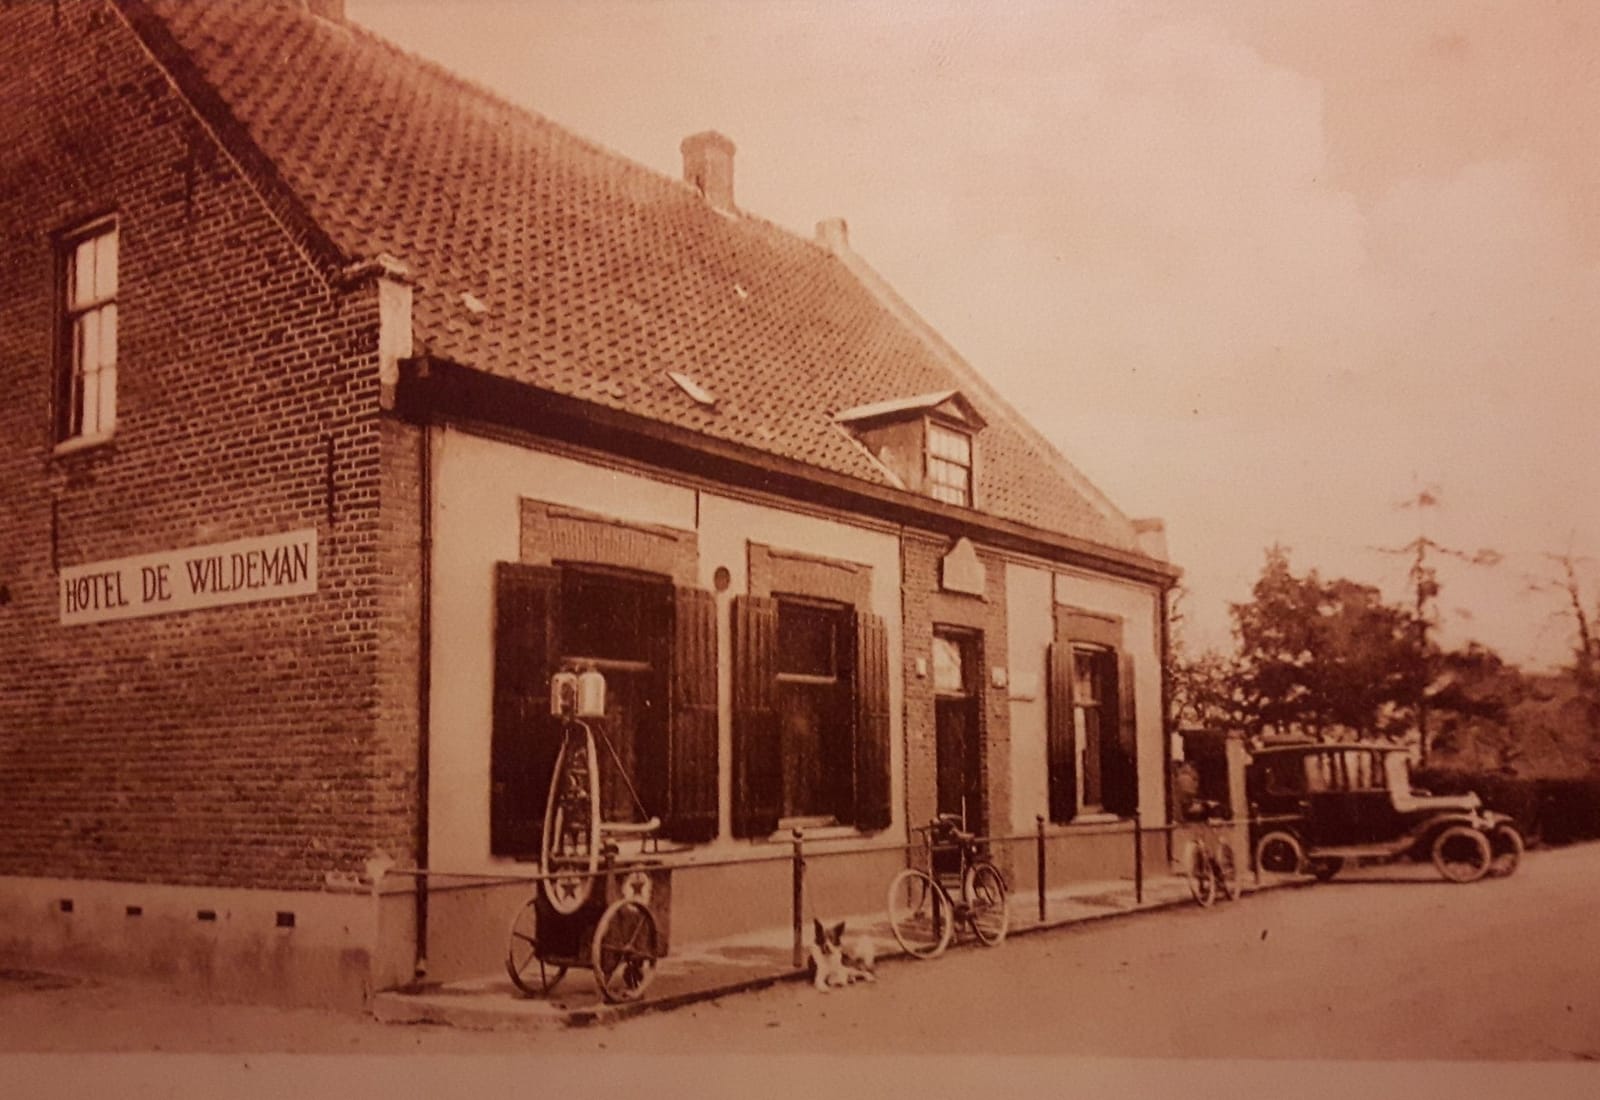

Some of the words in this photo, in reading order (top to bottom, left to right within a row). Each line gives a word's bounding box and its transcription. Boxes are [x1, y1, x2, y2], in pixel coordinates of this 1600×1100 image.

[64, 571, 129, 613] HOTEL
[142, 564, 172, 603] DE
[185, 543, 309, 594] WILDEMAN
